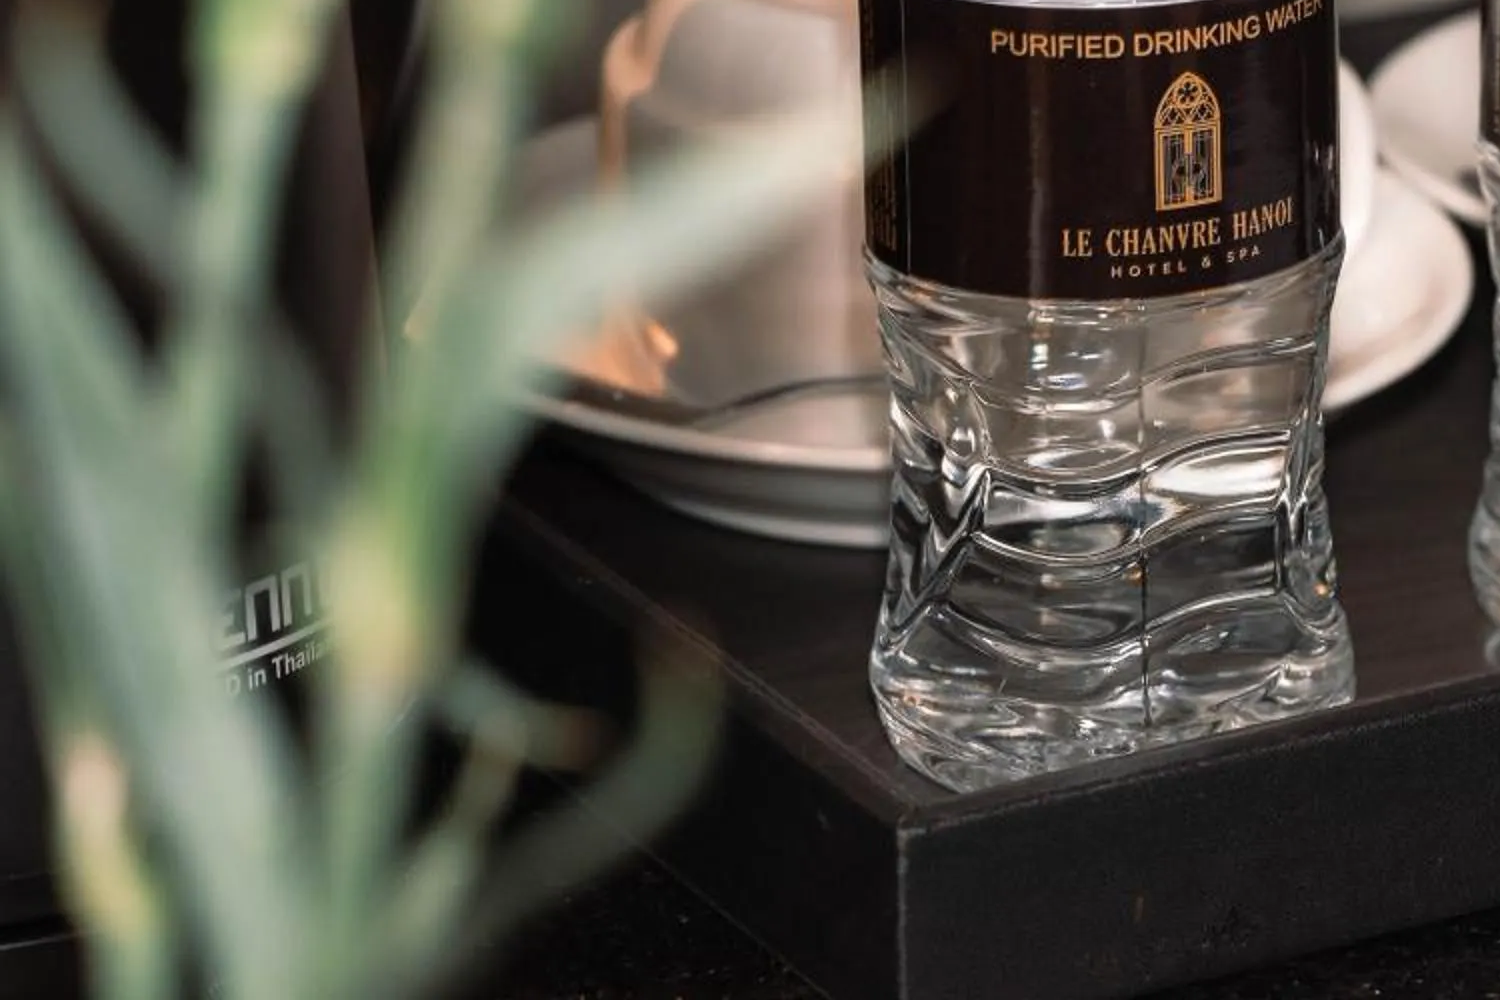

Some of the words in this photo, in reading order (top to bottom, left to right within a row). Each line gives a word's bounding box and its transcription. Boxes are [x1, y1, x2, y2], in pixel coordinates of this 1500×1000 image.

[990, 29, 1125, 60] PURIFIED
[1133, 14, 1261, 58] DRINKING
[1061, 228, 1093, 258] LE
[1105, 217, 1221, 258] CHANVRE
[1232, 196, 1295, 240] HANOI
[1110, 260, 1187, 279] HOTEL
[1201, 257, 1211, 268] &
[1227, 246, 1261, 264] SPA
[247, 666, 267, 691] in
